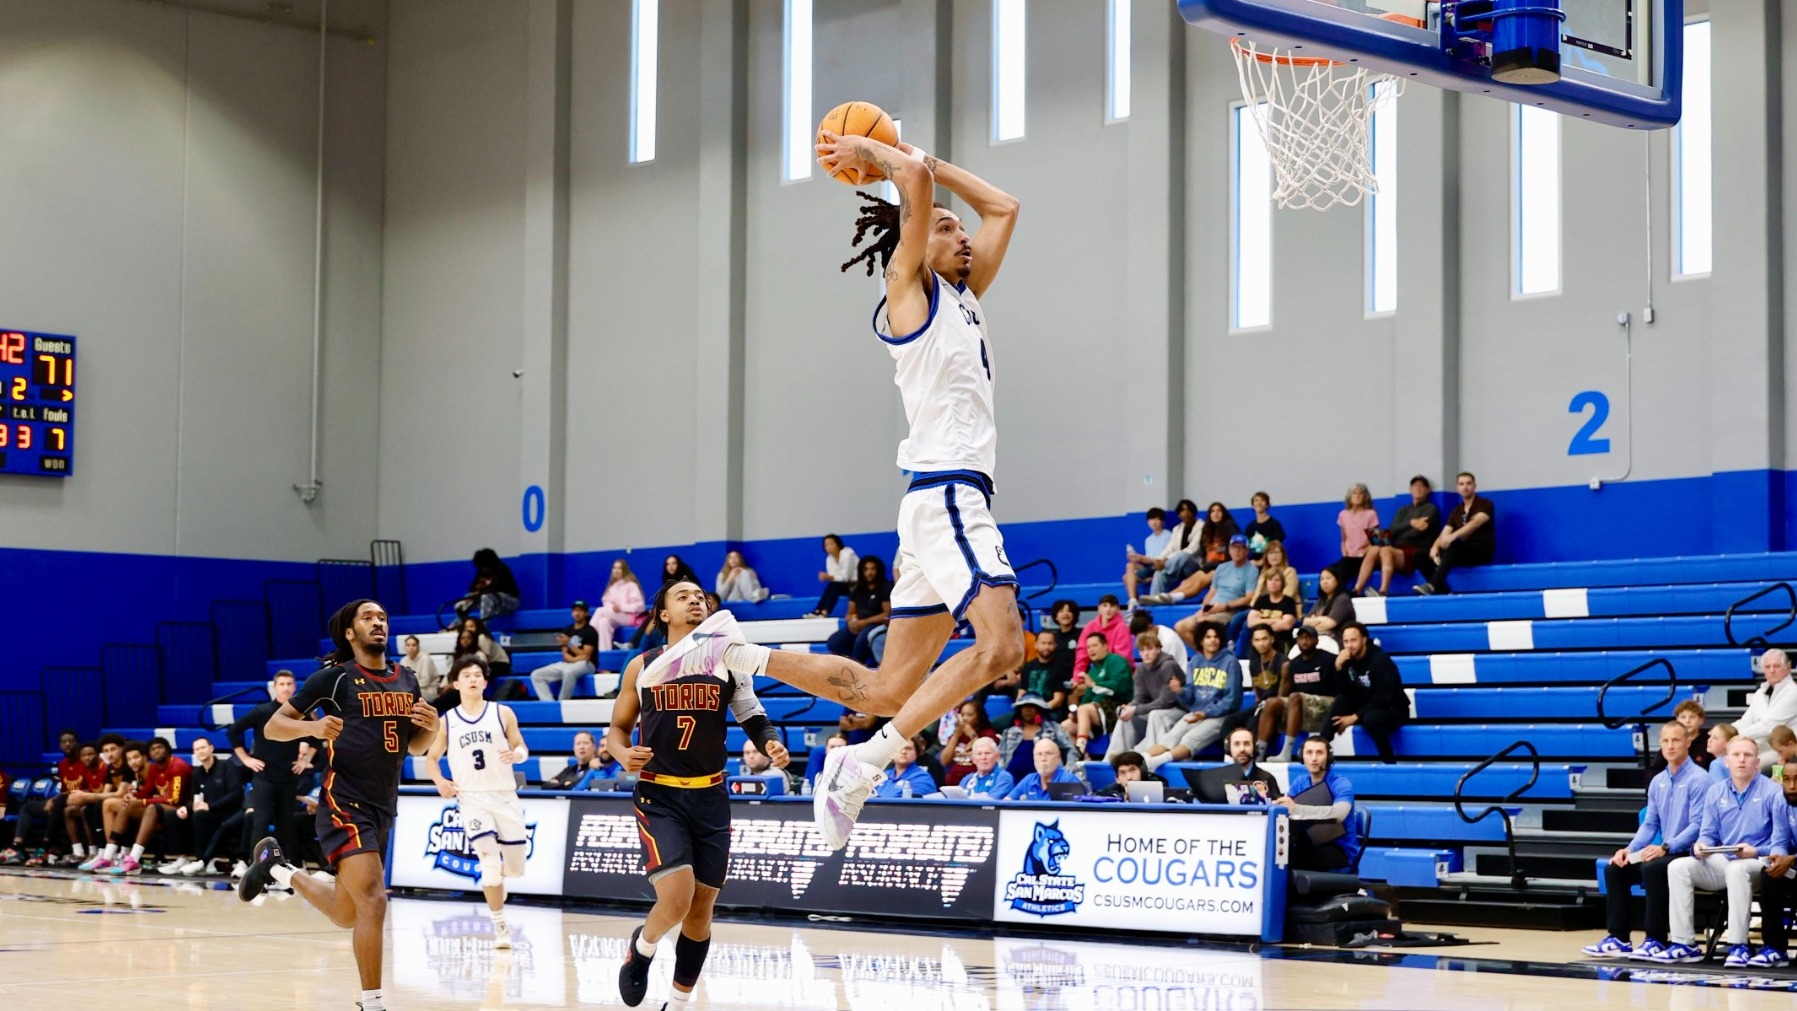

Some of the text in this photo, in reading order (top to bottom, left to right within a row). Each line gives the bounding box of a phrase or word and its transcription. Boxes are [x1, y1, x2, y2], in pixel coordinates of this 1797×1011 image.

[34, 337, 71, 354] Guests
[39, 355, 72, 386] 71
[12, 377, 26, 400] 2
[1568, 390, 1610, 456] 2
[17, 425, 31, 449] 3
[51, 428, 64, 450] 7
[522, 485, 545, 533] 0
[358, 691, 414, 717] TOROS
[651, 683, 721, 711] TOROS
[383, 721, 399, 753] 5
[459, 731, 493, 749] CSUSM
[676, 715, 696, 751] 7
[472, 749, 486, 771] 3
[442, 809, 464, 828] CA
[1107, 834, 1247, 857] HOME OF THE
[1040, 874, 1076, 887] STATE
[1093, 856, 1258, 889] COUGARS
[1006, 884, 1085, 904] SAN MARCOS
[1093, 894, 1254, 914] CSUSMCOUGARS.COM
[1021, 902, 1066, 913] ATHLETICS
